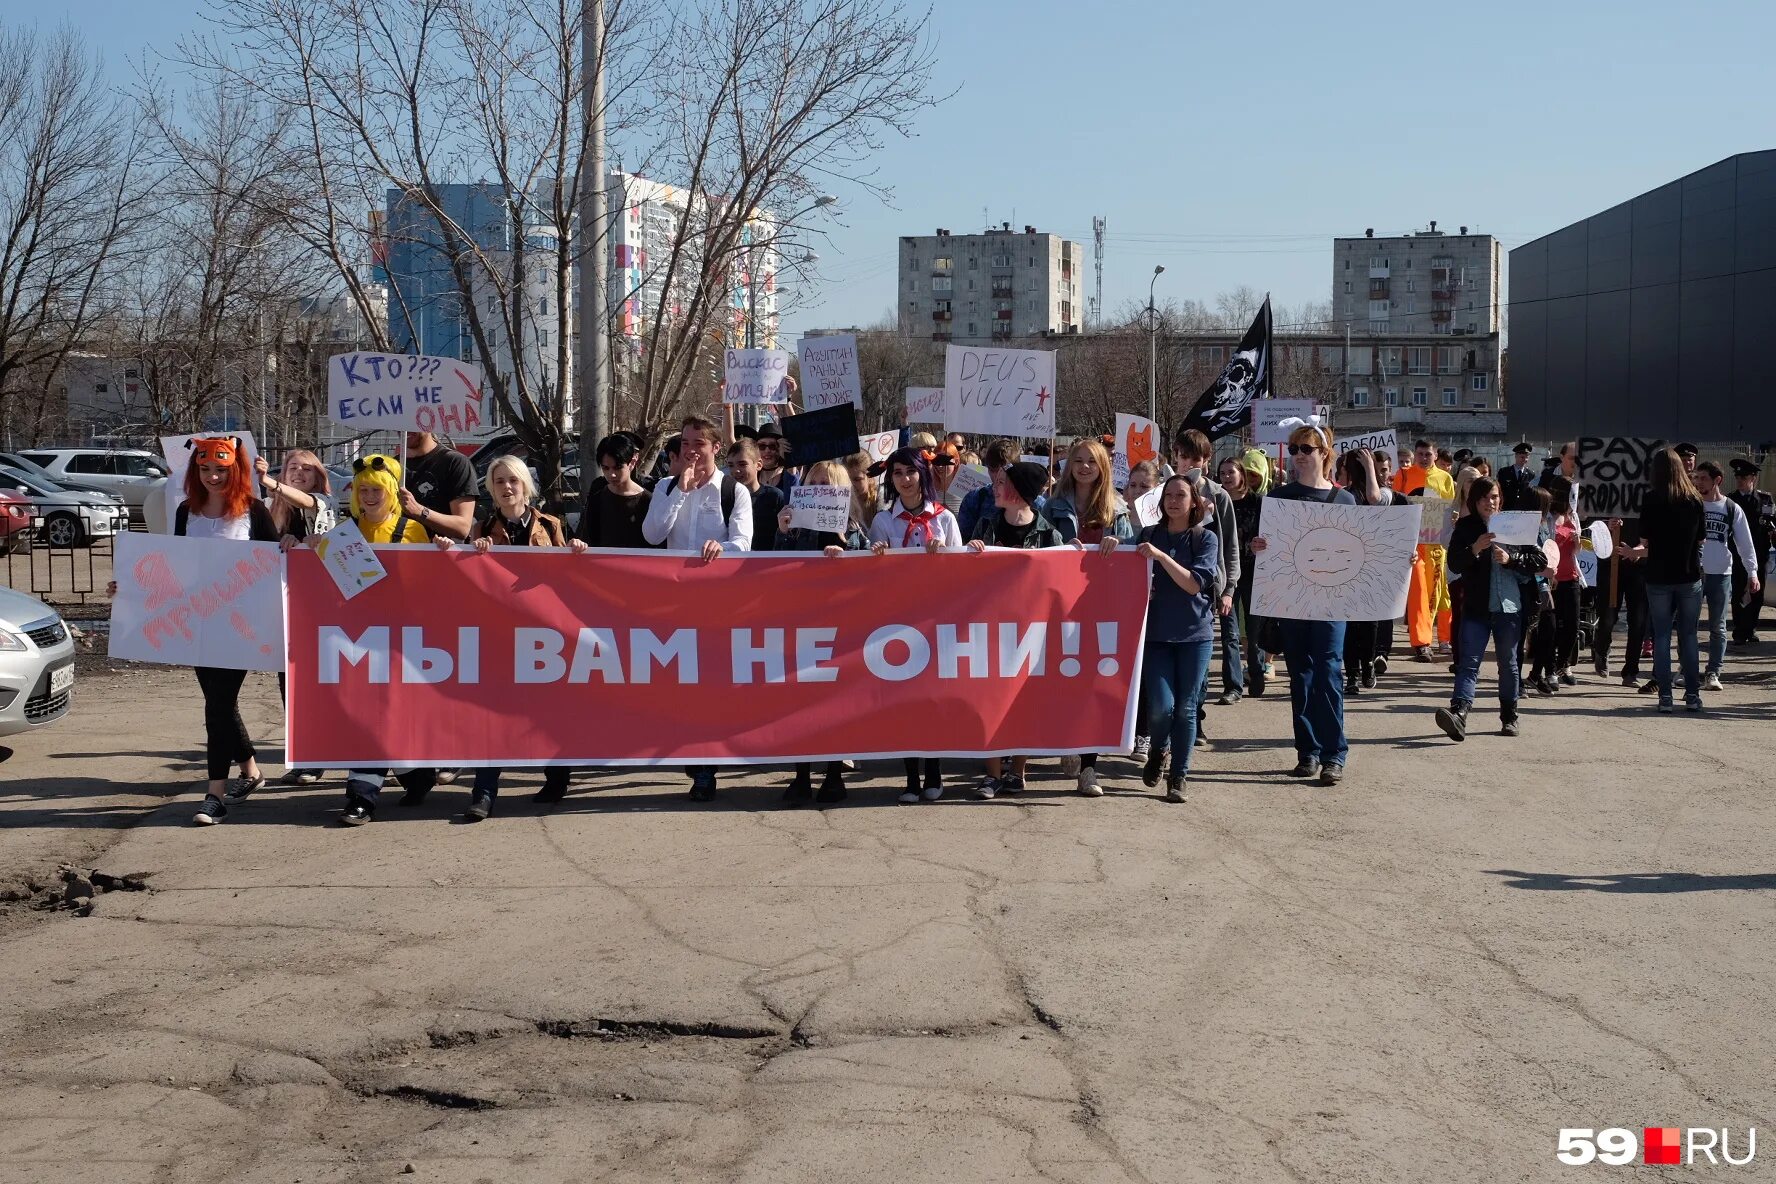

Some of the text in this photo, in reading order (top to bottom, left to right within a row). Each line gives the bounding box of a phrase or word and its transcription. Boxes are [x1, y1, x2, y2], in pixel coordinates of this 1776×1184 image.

[340, 354, 441, 387] КТО???
[960, 352, 1037, 382] DEUS
[339, 386, 442, 420] ЕСЛИ НЕ
[960, 387, 1031, 408] VULT
[416, 401, 481, 433] ОНА
[1578, 437, 1664, 465] PAY
[319, 620, 1119, 684] МЫ ВАМ НЕ ОНИ!!
